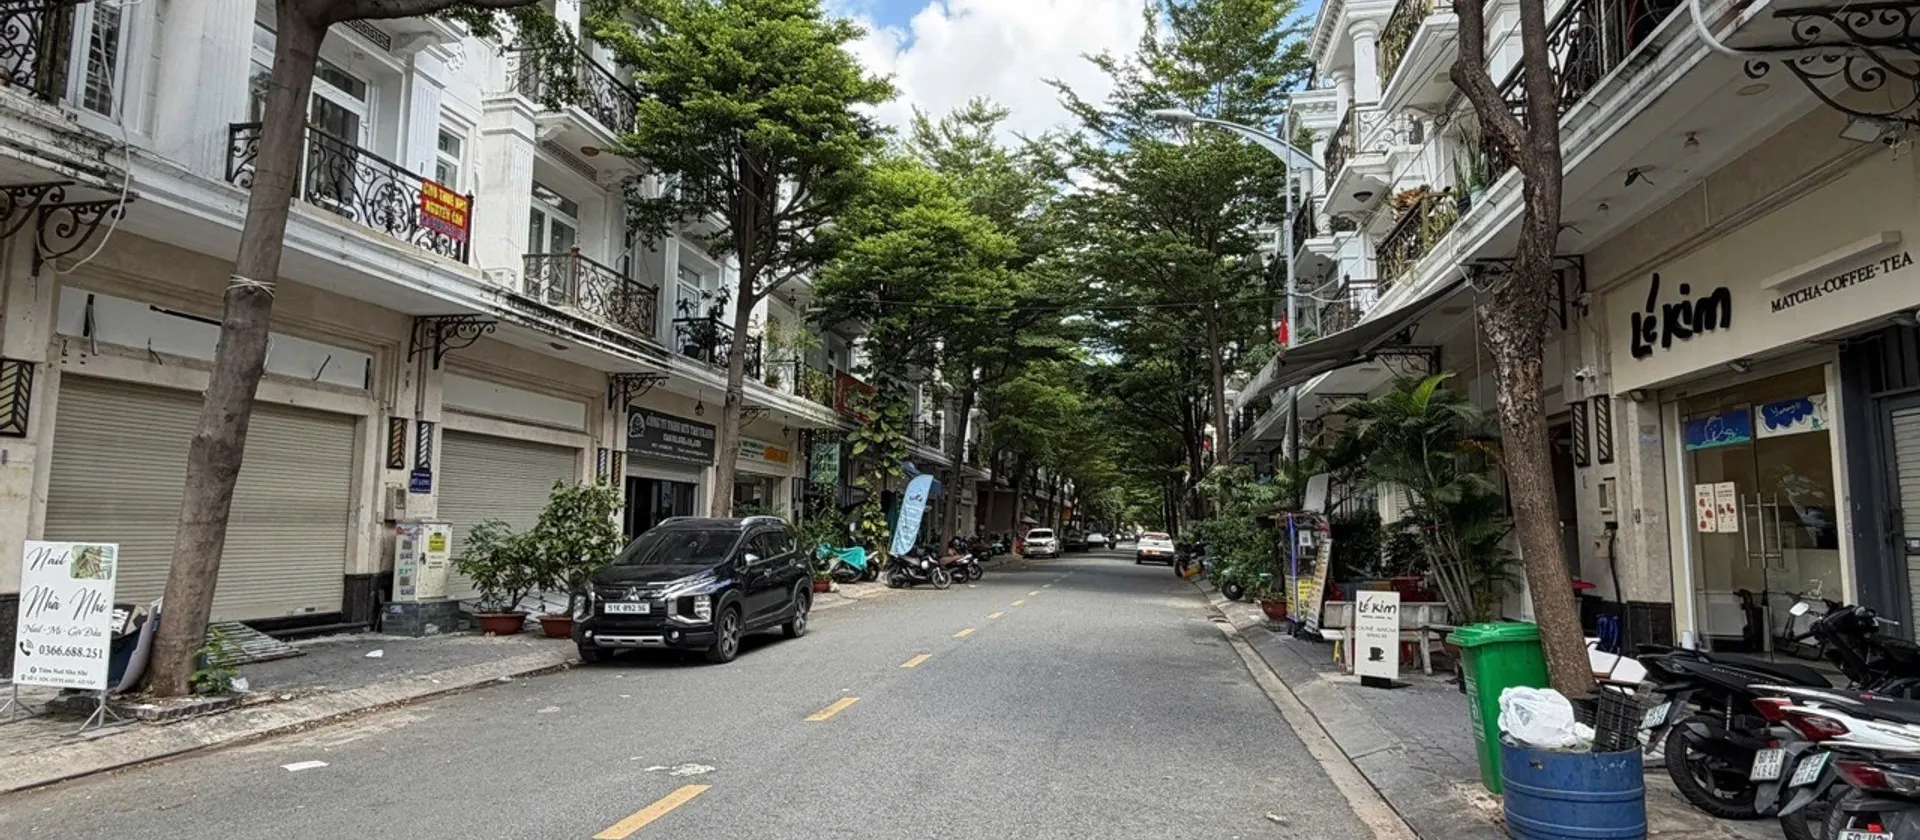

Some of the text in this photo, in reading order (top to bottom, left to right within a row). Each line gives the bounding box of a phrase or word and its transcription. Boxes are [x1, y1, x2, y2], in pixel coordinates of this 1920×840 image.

[25, 545, 69, 572] Nail
[21, 584, 108, 621] Nhà Nhi
[1372, 599, 1397, 615] Kim
[38, 644, 103, 660] 0366.688.251
